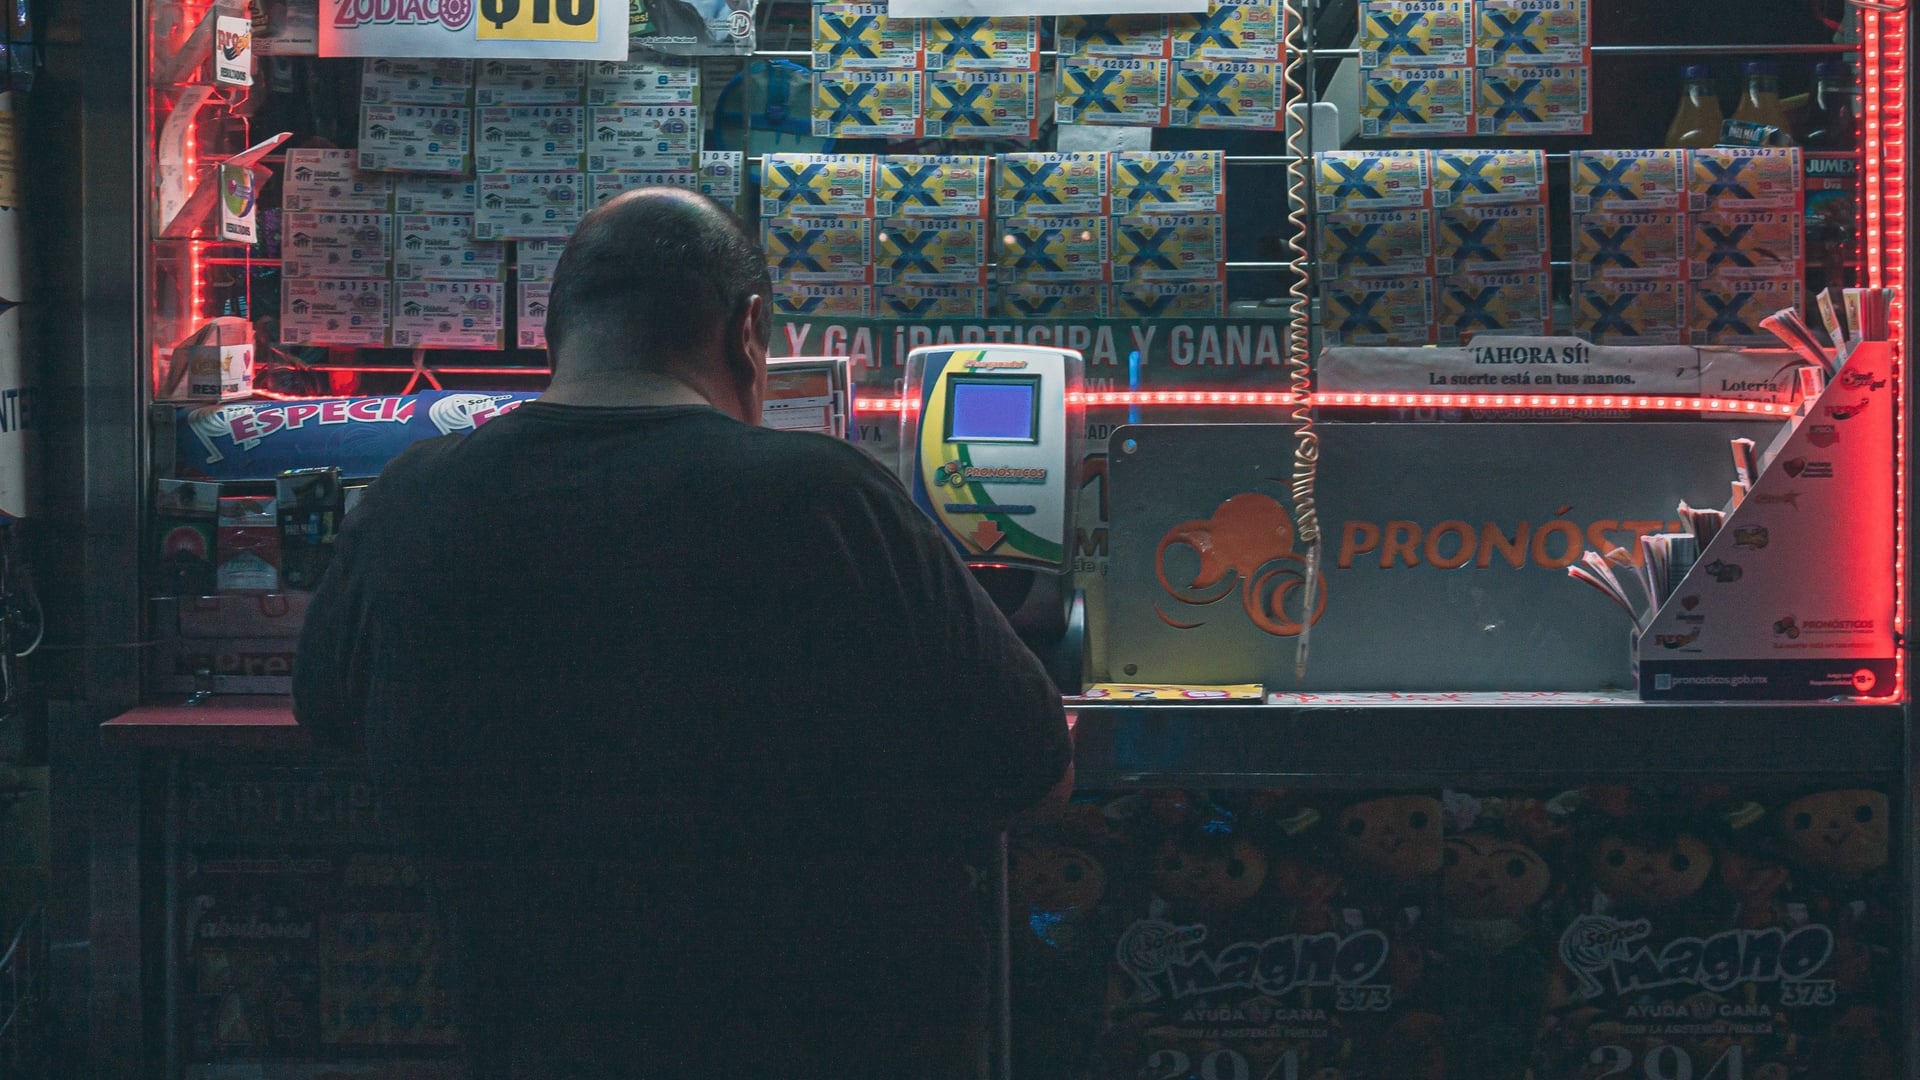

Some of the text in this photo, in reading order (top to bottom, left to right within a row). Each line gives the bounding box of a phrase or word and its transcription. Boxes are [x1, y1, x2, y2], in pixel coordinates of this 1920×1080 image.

[858, 6, 888, 14] 1513
[1806, 159, 1856, 173] JUMEX
[836, 169, 860, 178] 54
[950, 170, 974, 179] 54
[822, 325, 882, 368] GA
[1130, 325, 1156, 365] Y
[1475, 343, 1590, 364] ¡AHORA SÍ!
[1429, 371, 1636, 385] La suerte está en tus manos.
[1721, 379, 1778, 392] Lotería
[468, 395, 512, 406] Sorteo
[966, 465, 1046, 478] PRONÓSTICOS
[1337, 504, 1682, 570] PRONÓST
